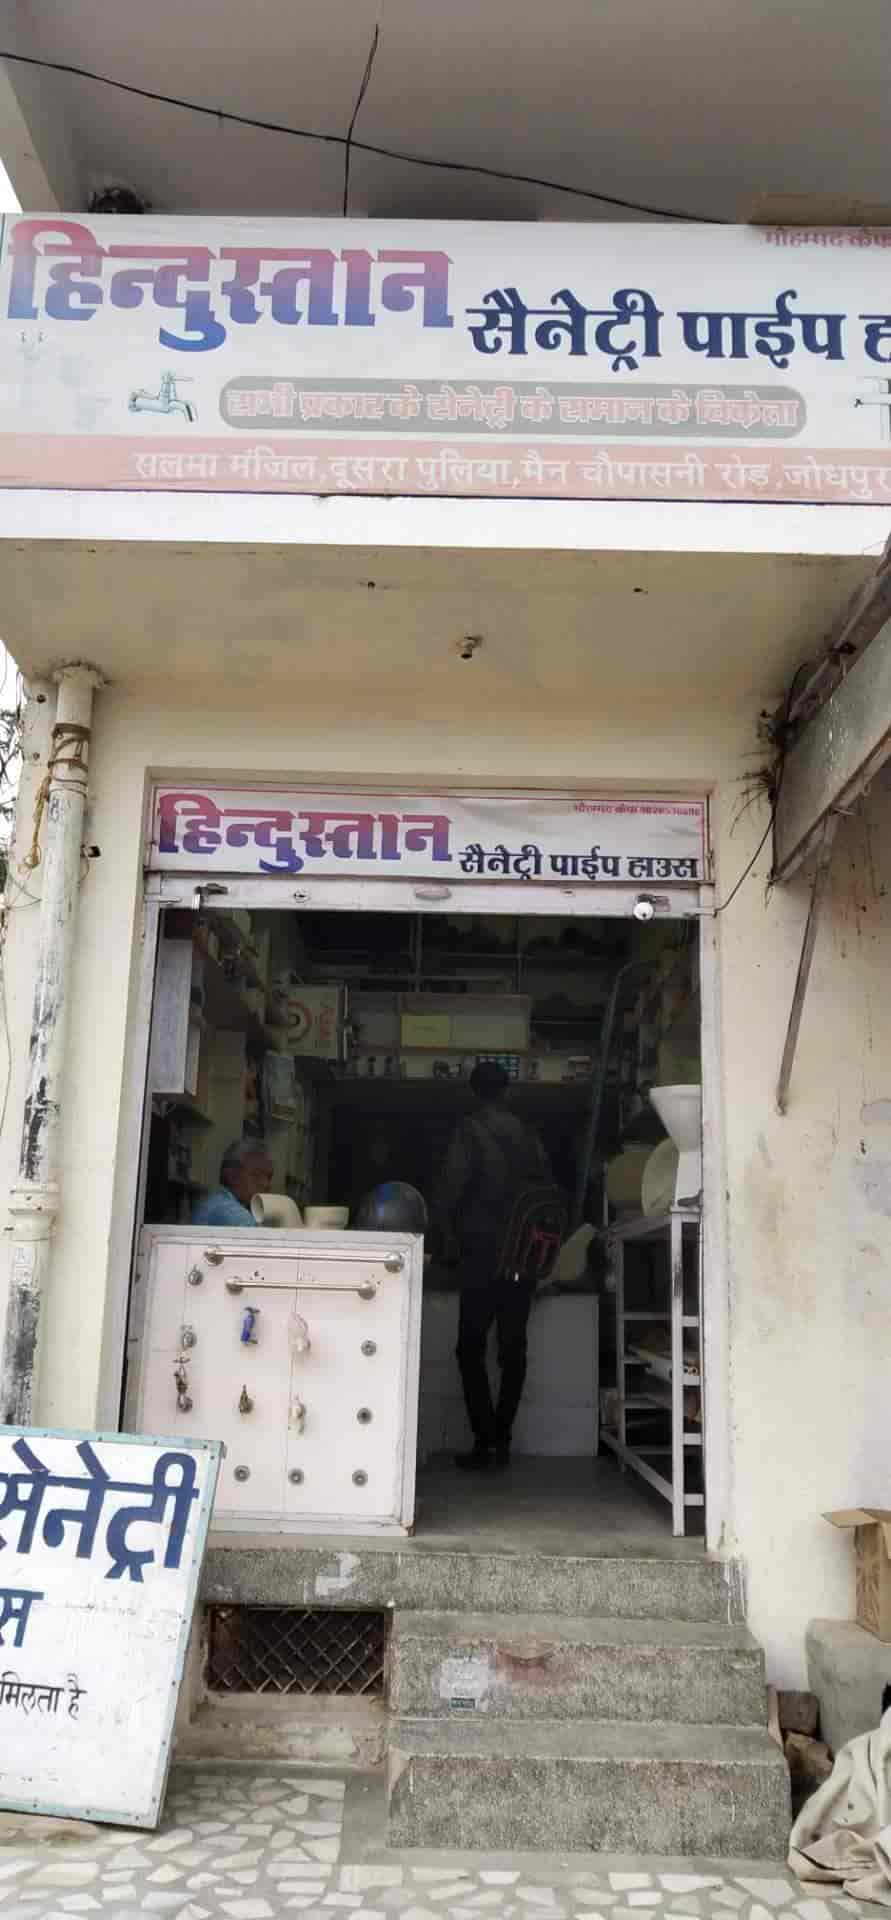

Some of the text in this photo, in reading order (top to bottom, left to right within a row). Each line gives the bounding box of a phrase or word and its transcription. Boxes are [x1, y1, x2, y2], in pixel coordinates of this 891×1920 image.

[7, 219, 455, 352] हिन्दुस्तान
[466, 287, 664, 373] सैनेट्री
[677, 289, 847, 369] पाईप
[158, 793, 700, 880] हिन्दुस्तान सैनेट्री पाईप हाउस
[66, 1672, 87, 1721] है
